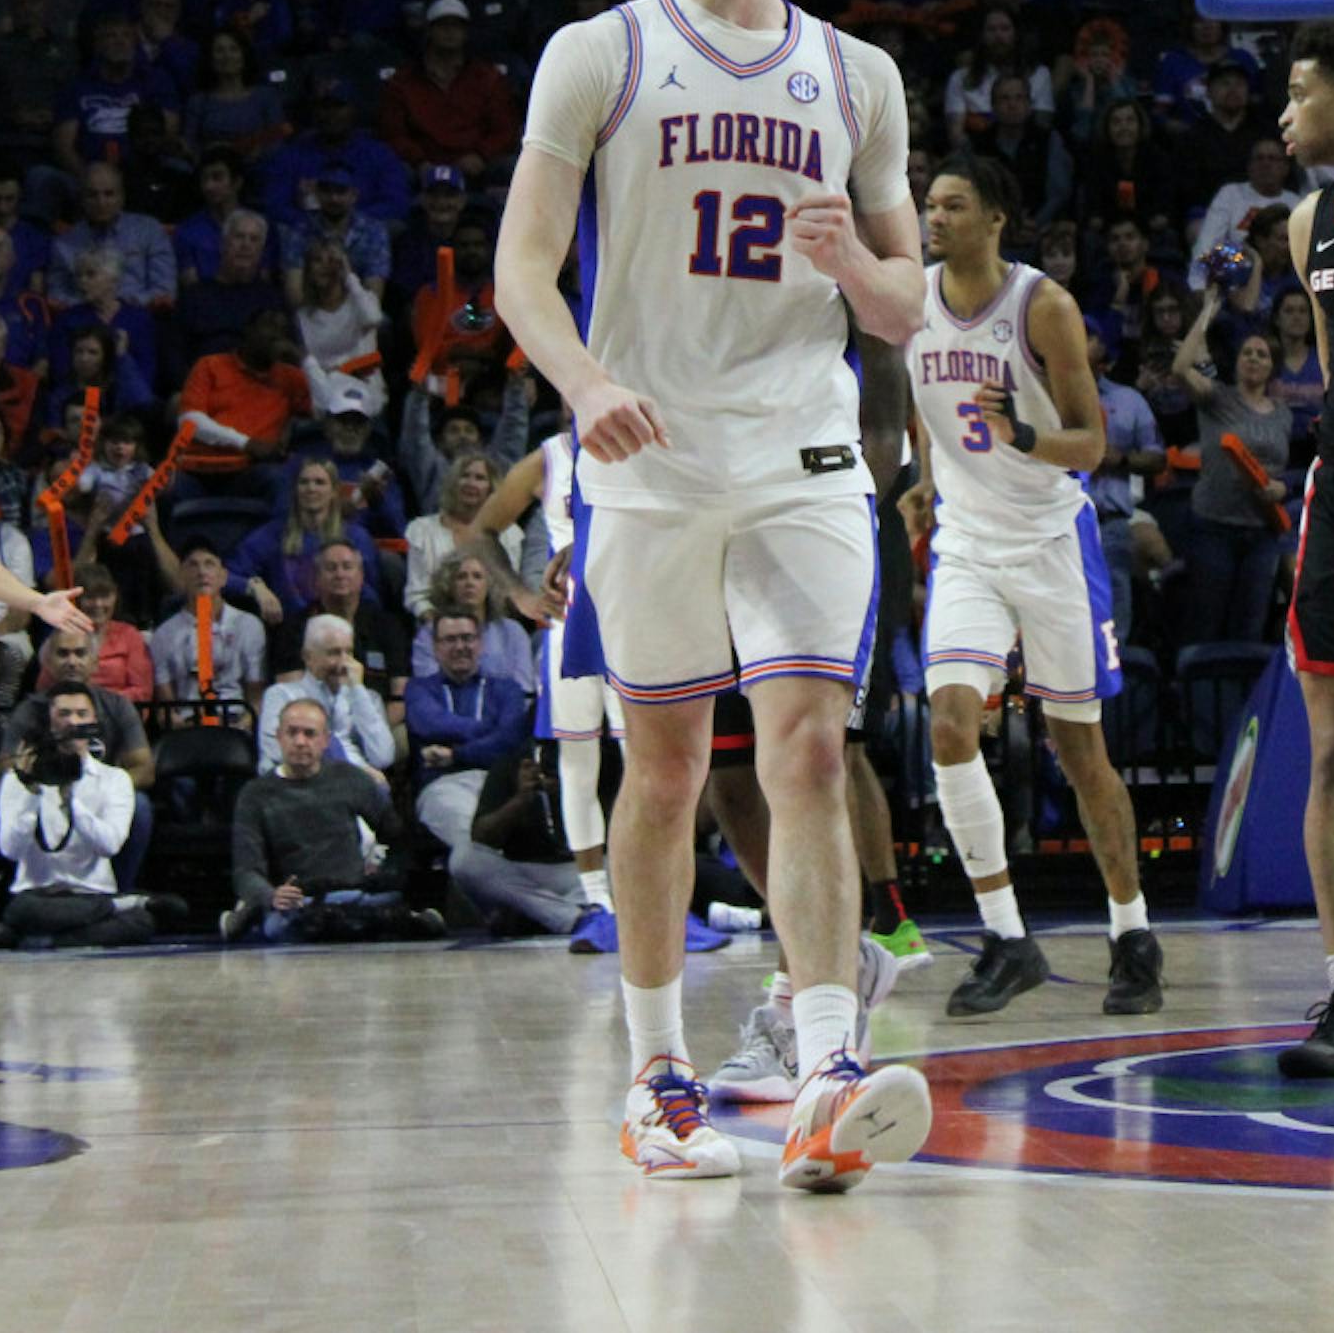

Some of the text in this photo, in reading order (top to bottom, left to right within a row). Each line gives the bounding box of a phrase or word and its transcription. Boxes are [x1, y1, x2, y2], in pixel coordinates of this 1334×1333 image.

[659, 112, 824, 183] FLORIDA
[688, 189, 786, 283] 12
[957, 402, 992, 453] 3
